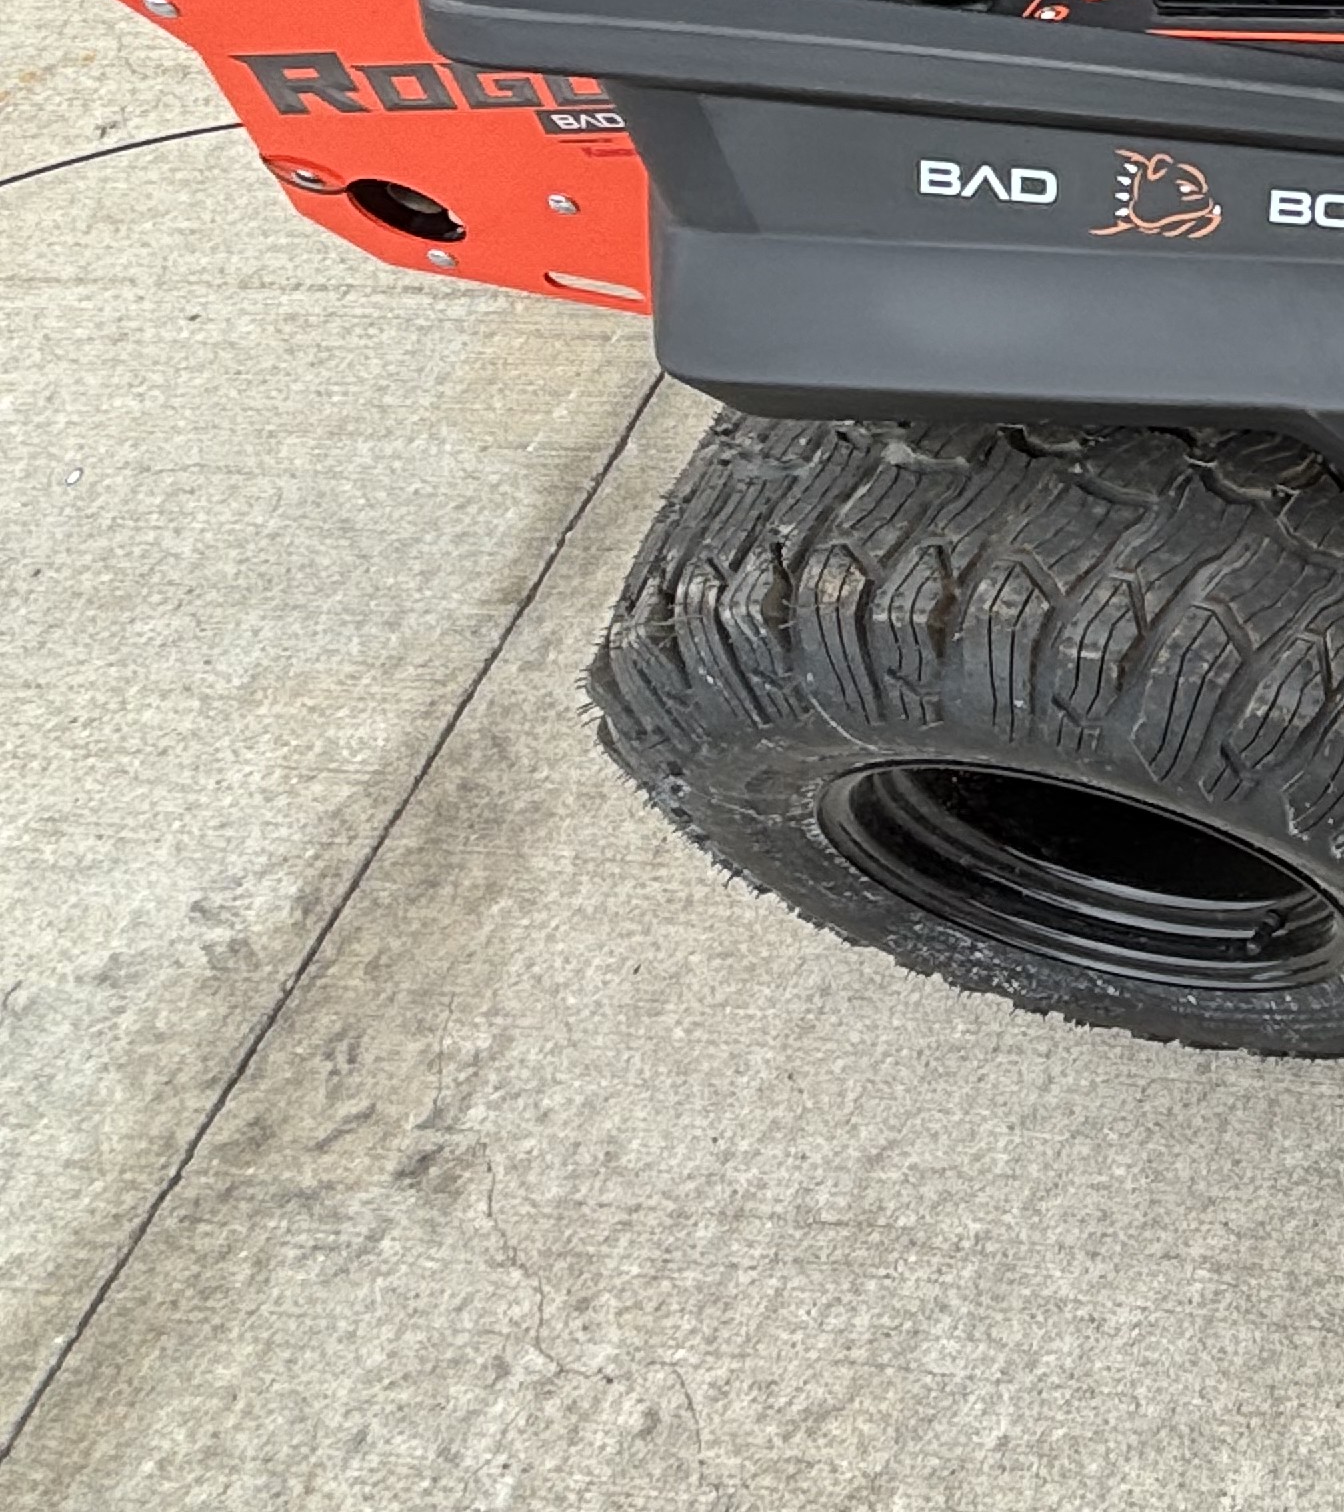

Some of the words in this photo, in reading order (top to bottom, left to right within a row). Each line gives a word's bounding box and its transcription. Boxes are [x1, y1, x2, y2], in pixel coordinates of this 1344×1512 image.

[229, 52, 615, 114] ROGU
[550, 112, 626, 130] BAD
[918, 159, 1058, 204] BAD
